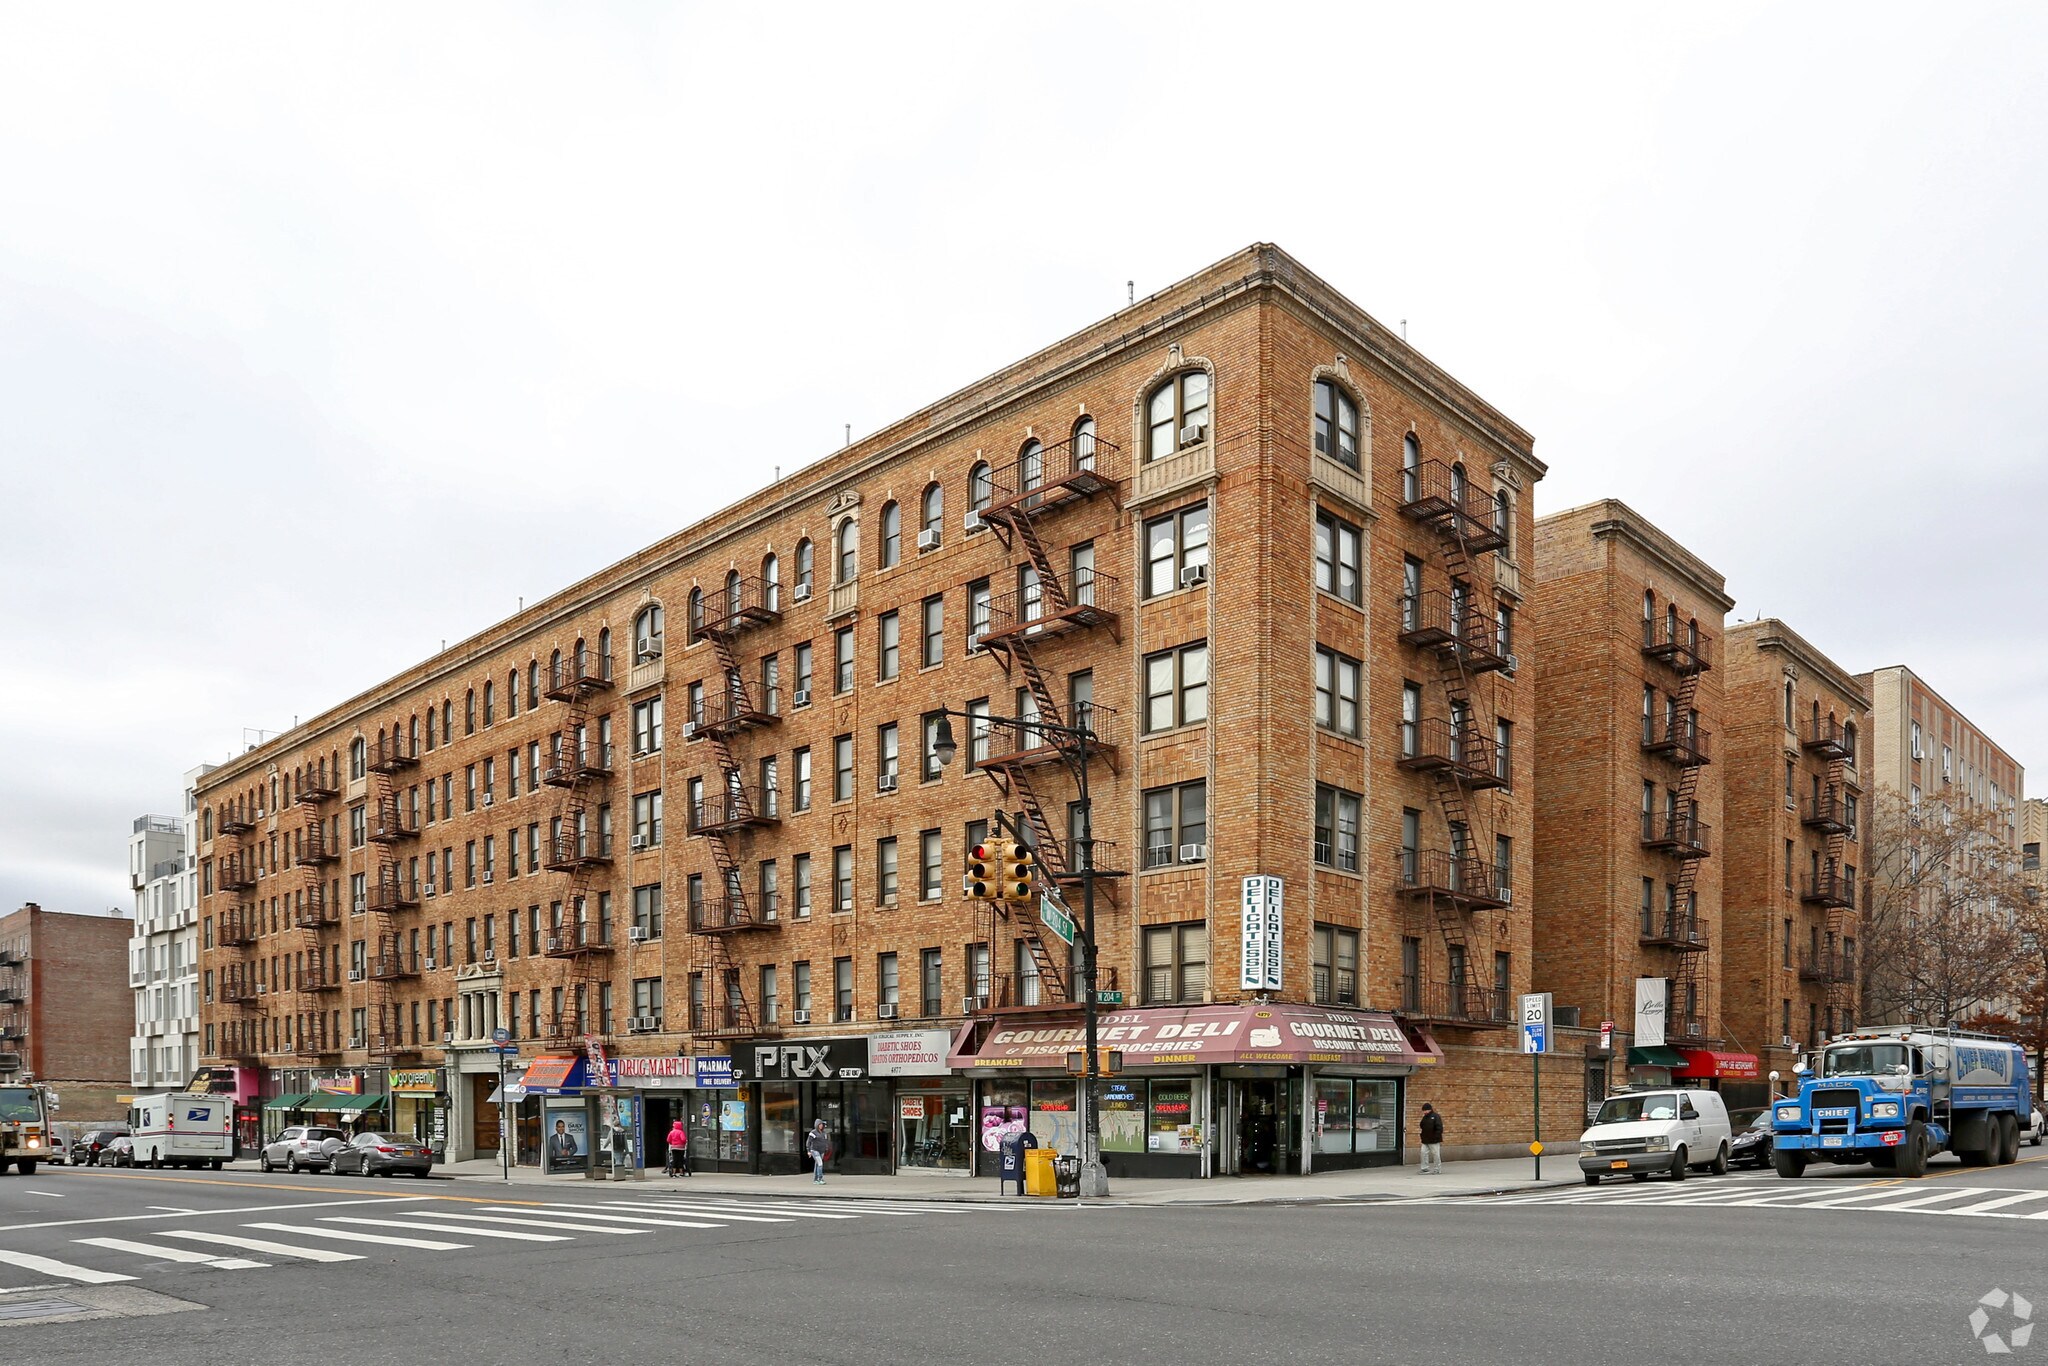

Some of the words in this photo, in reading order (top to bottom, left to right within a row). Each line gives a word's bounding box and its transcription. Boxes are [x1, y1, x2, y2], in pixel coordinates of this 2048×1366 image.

[1052, 913, 1061, 930] 204
[1245, 879, 1261, 984] DELICATESSEN
[1268, 879, 1279, 985] DELICATESSEN
[1103, 993, 1114, 1001] 204
[1325, 1013, 1358, 1024] FIDEL
[1526, 1010, 1541, 1021] 20
[993, 1025, 1150, 1045] GOURMET
[1155, 1021, 1241, 1039] DELI
[1290, 1022, 1367, 1041] GOURMET
[1371, 1027, 1404, 1042] DELI
[877, 1041, 900, 1052] DIABETIC
[900, 1041, 922, 1051] SHOES
[1006, 1047, 1016, 1055] &
[1022, 1045, 1103, 1055] DISCOU
[1313, 1040, 1357, 1051] DISCOUNT
[1357, 1042, 1403, 1053] GROCERIES
[888, 1053, 939, 1063] ORTHOPEDICOS
[974, 1058, 1023, 1067] BREAKFAST
[1153, 1054, 1196, 1063] DINNER
[1308, 1054, 1342, 1063] BREAKFAST
[619, 1059, 646, 1076] DRUG
[649, 1059, 678, 1076] MART
[698, 1060, 732, 1073] PHARMAC
[399, 1072, 407, 1087] go
[408, 1070, 434, 1087] greenly
[1158, 1093, 1173, 1101] COLD
[1174, 1093, 1190, 1101] BEER
[1818, 1109, 1851, 1117] CHIEF
